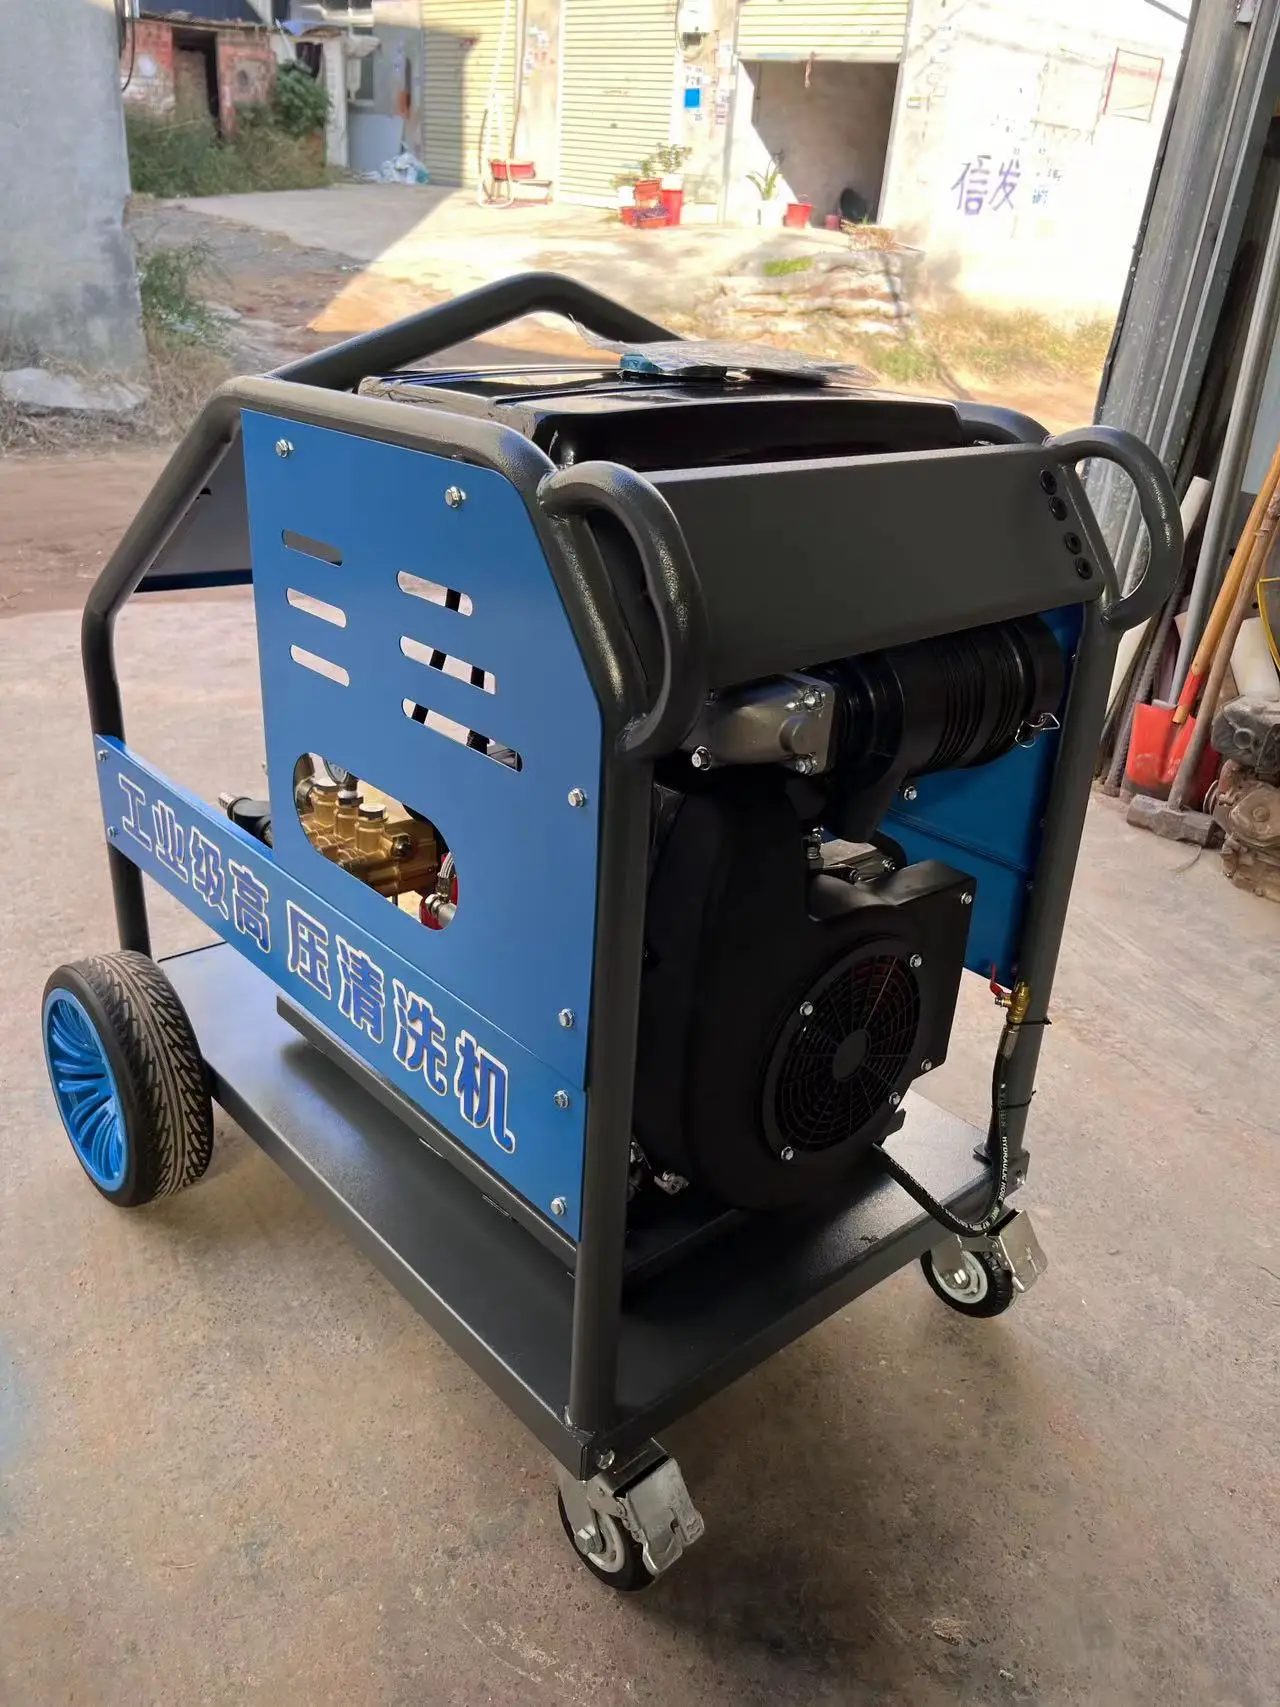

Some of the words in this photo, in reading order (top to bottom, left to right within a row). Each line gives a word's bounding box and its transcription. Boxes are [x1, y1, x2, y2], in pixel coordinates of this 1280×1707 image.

[951, 154, 1021, 216] 信发
[118, 773, 516, 1154] 工业级高压清洗机
[998, 1181, 1006, 1201] HOSE
